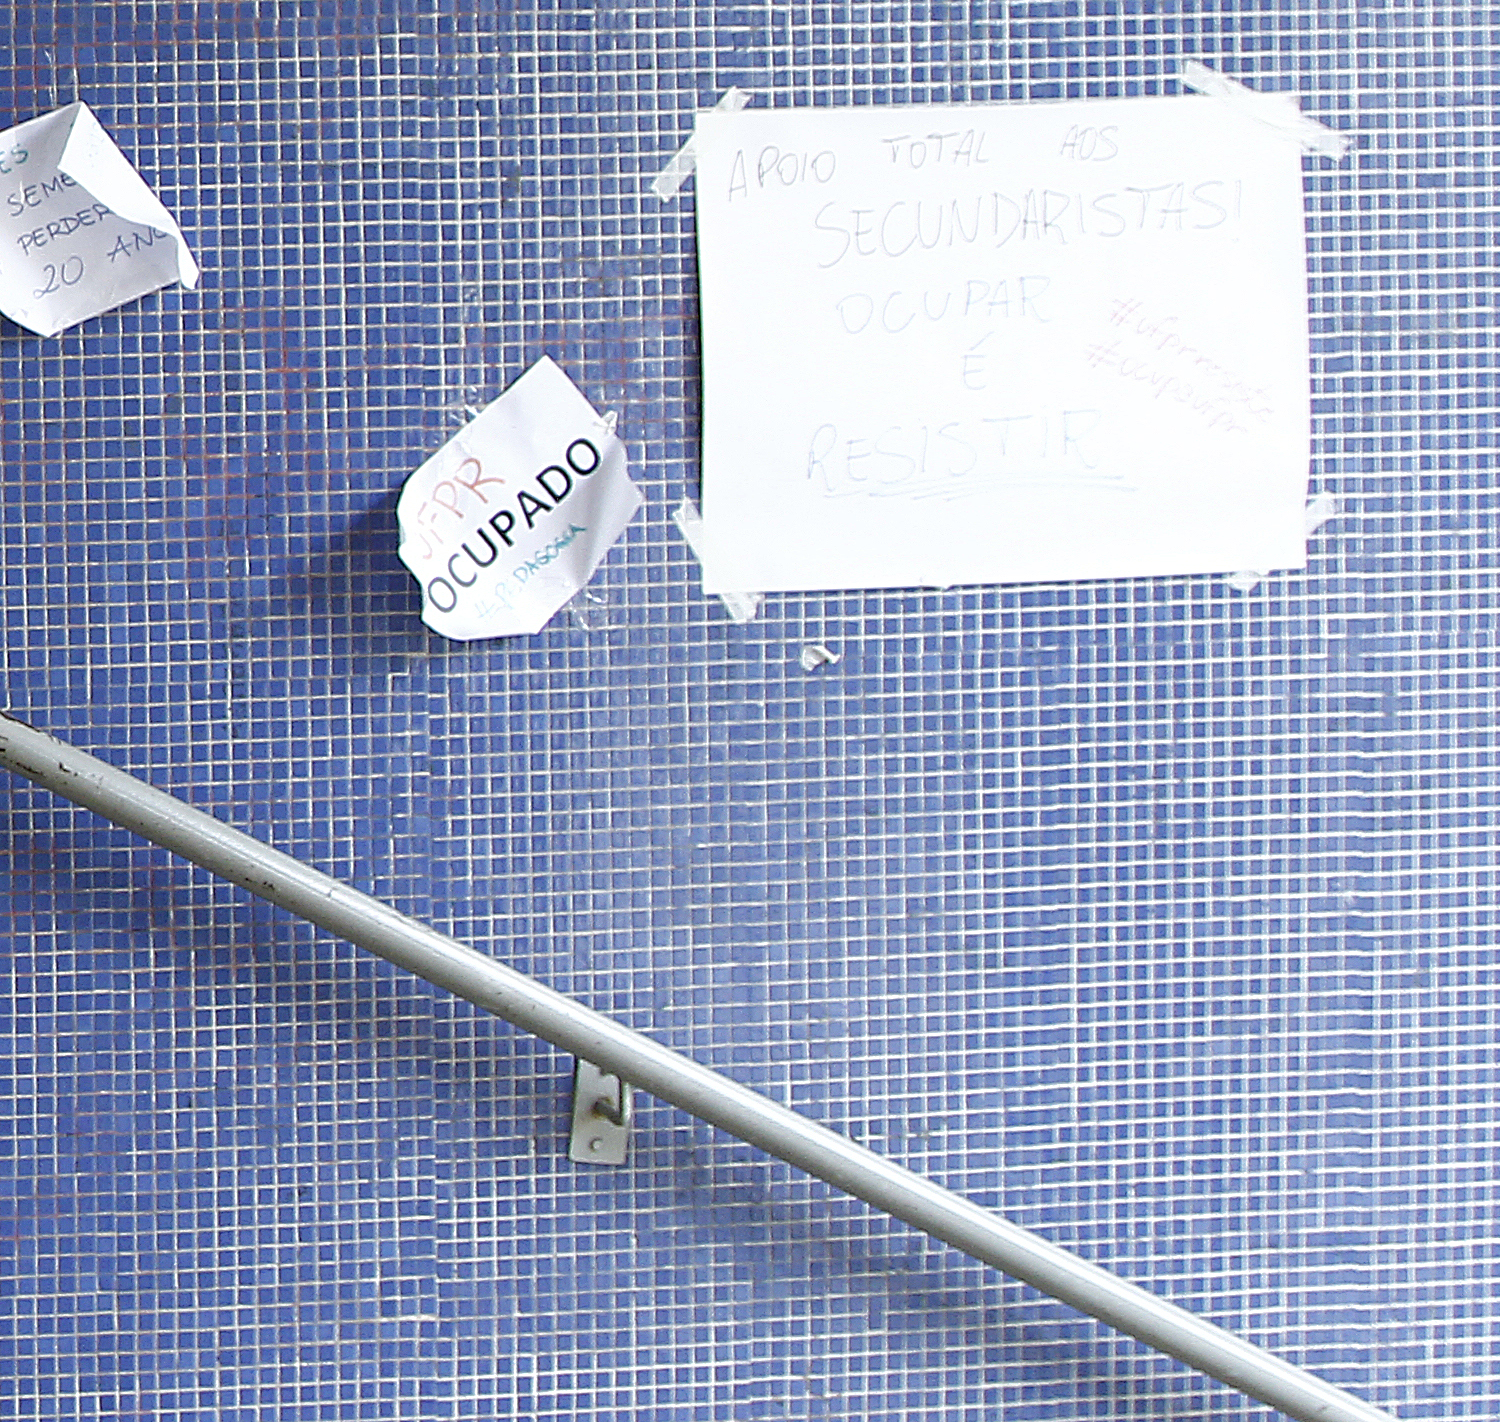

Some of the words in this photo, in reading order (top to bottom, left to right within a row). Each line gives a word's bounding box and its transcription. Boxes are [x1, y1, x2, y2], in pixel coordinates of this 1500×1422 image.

[726, 144, 837, 202] APOIO
[881, 128, 990, 169] TOTAL
[1060, 124, 1120, 163] AOS
[813, 178, 1244, 269] SECUNDARISTAS!
[33, 255, 85, 299] 20
[835, 274, 1052, 335] OCUPAR
[961, 330, 995, 391] É
[806, 404, 1103, 493] RESISTIR
[427, 438, 601, 613] OCUPADO
